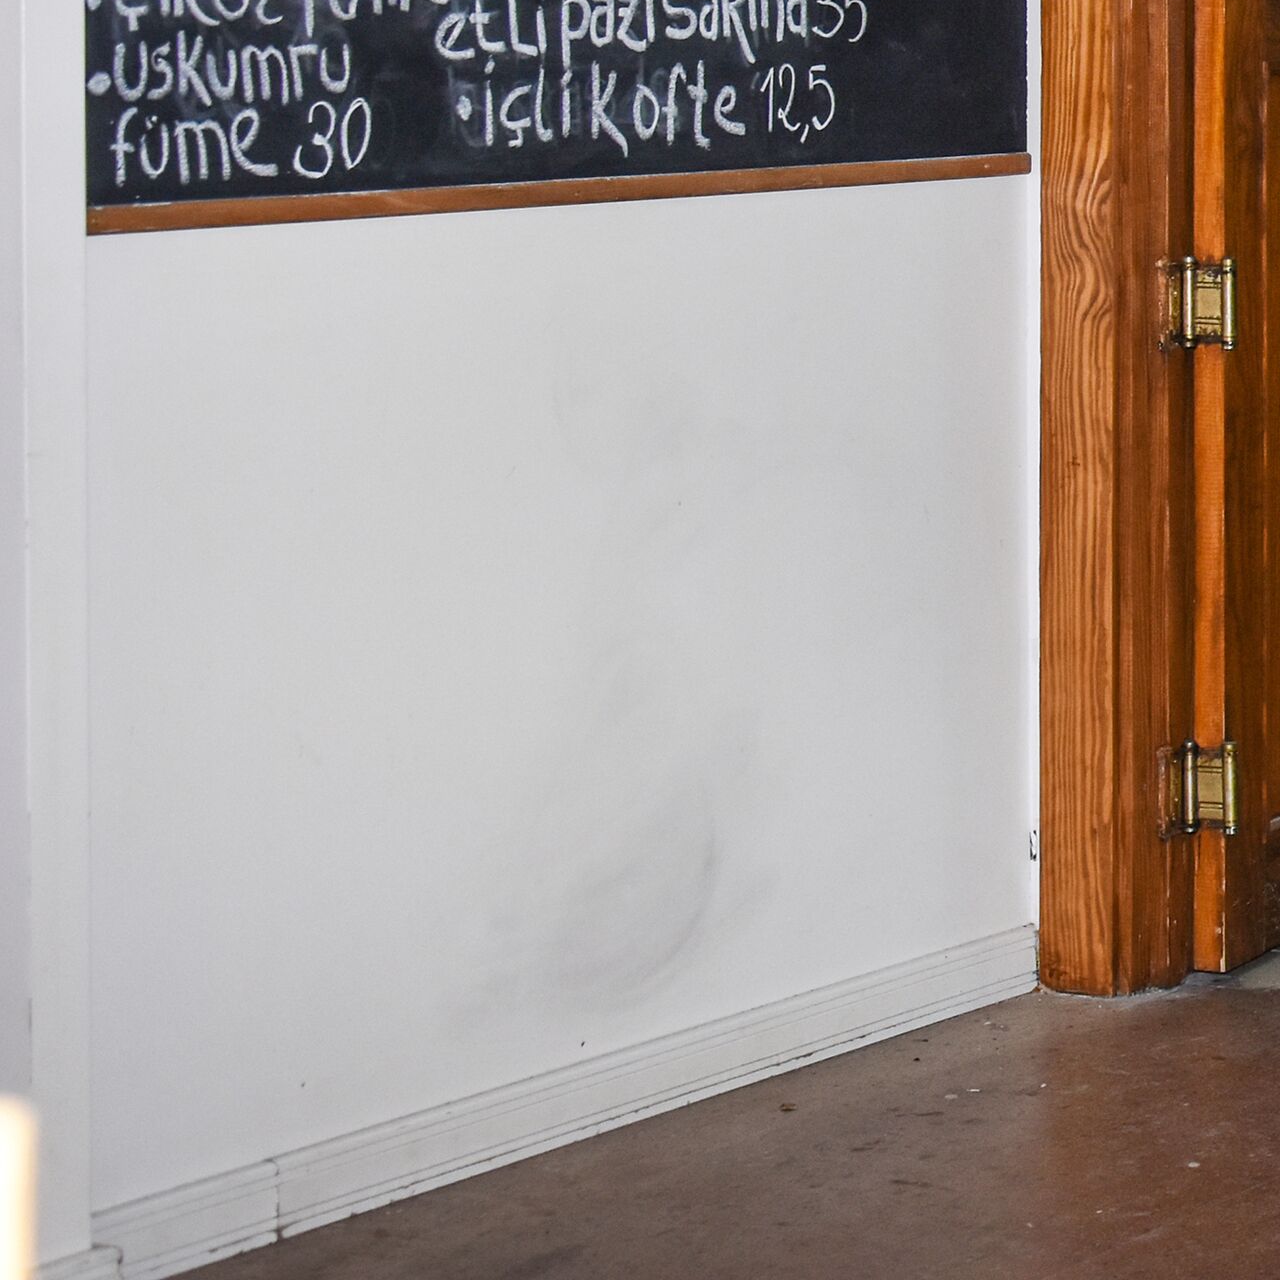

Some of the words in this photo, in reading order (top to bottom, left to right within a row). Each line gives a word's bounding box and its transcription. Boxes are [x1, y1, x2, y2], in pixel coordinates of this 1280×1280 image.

[113, 30, 352, 107] uskumru
[110, 106, 279, 187] füme
[293, 97, 373, 179] 30
